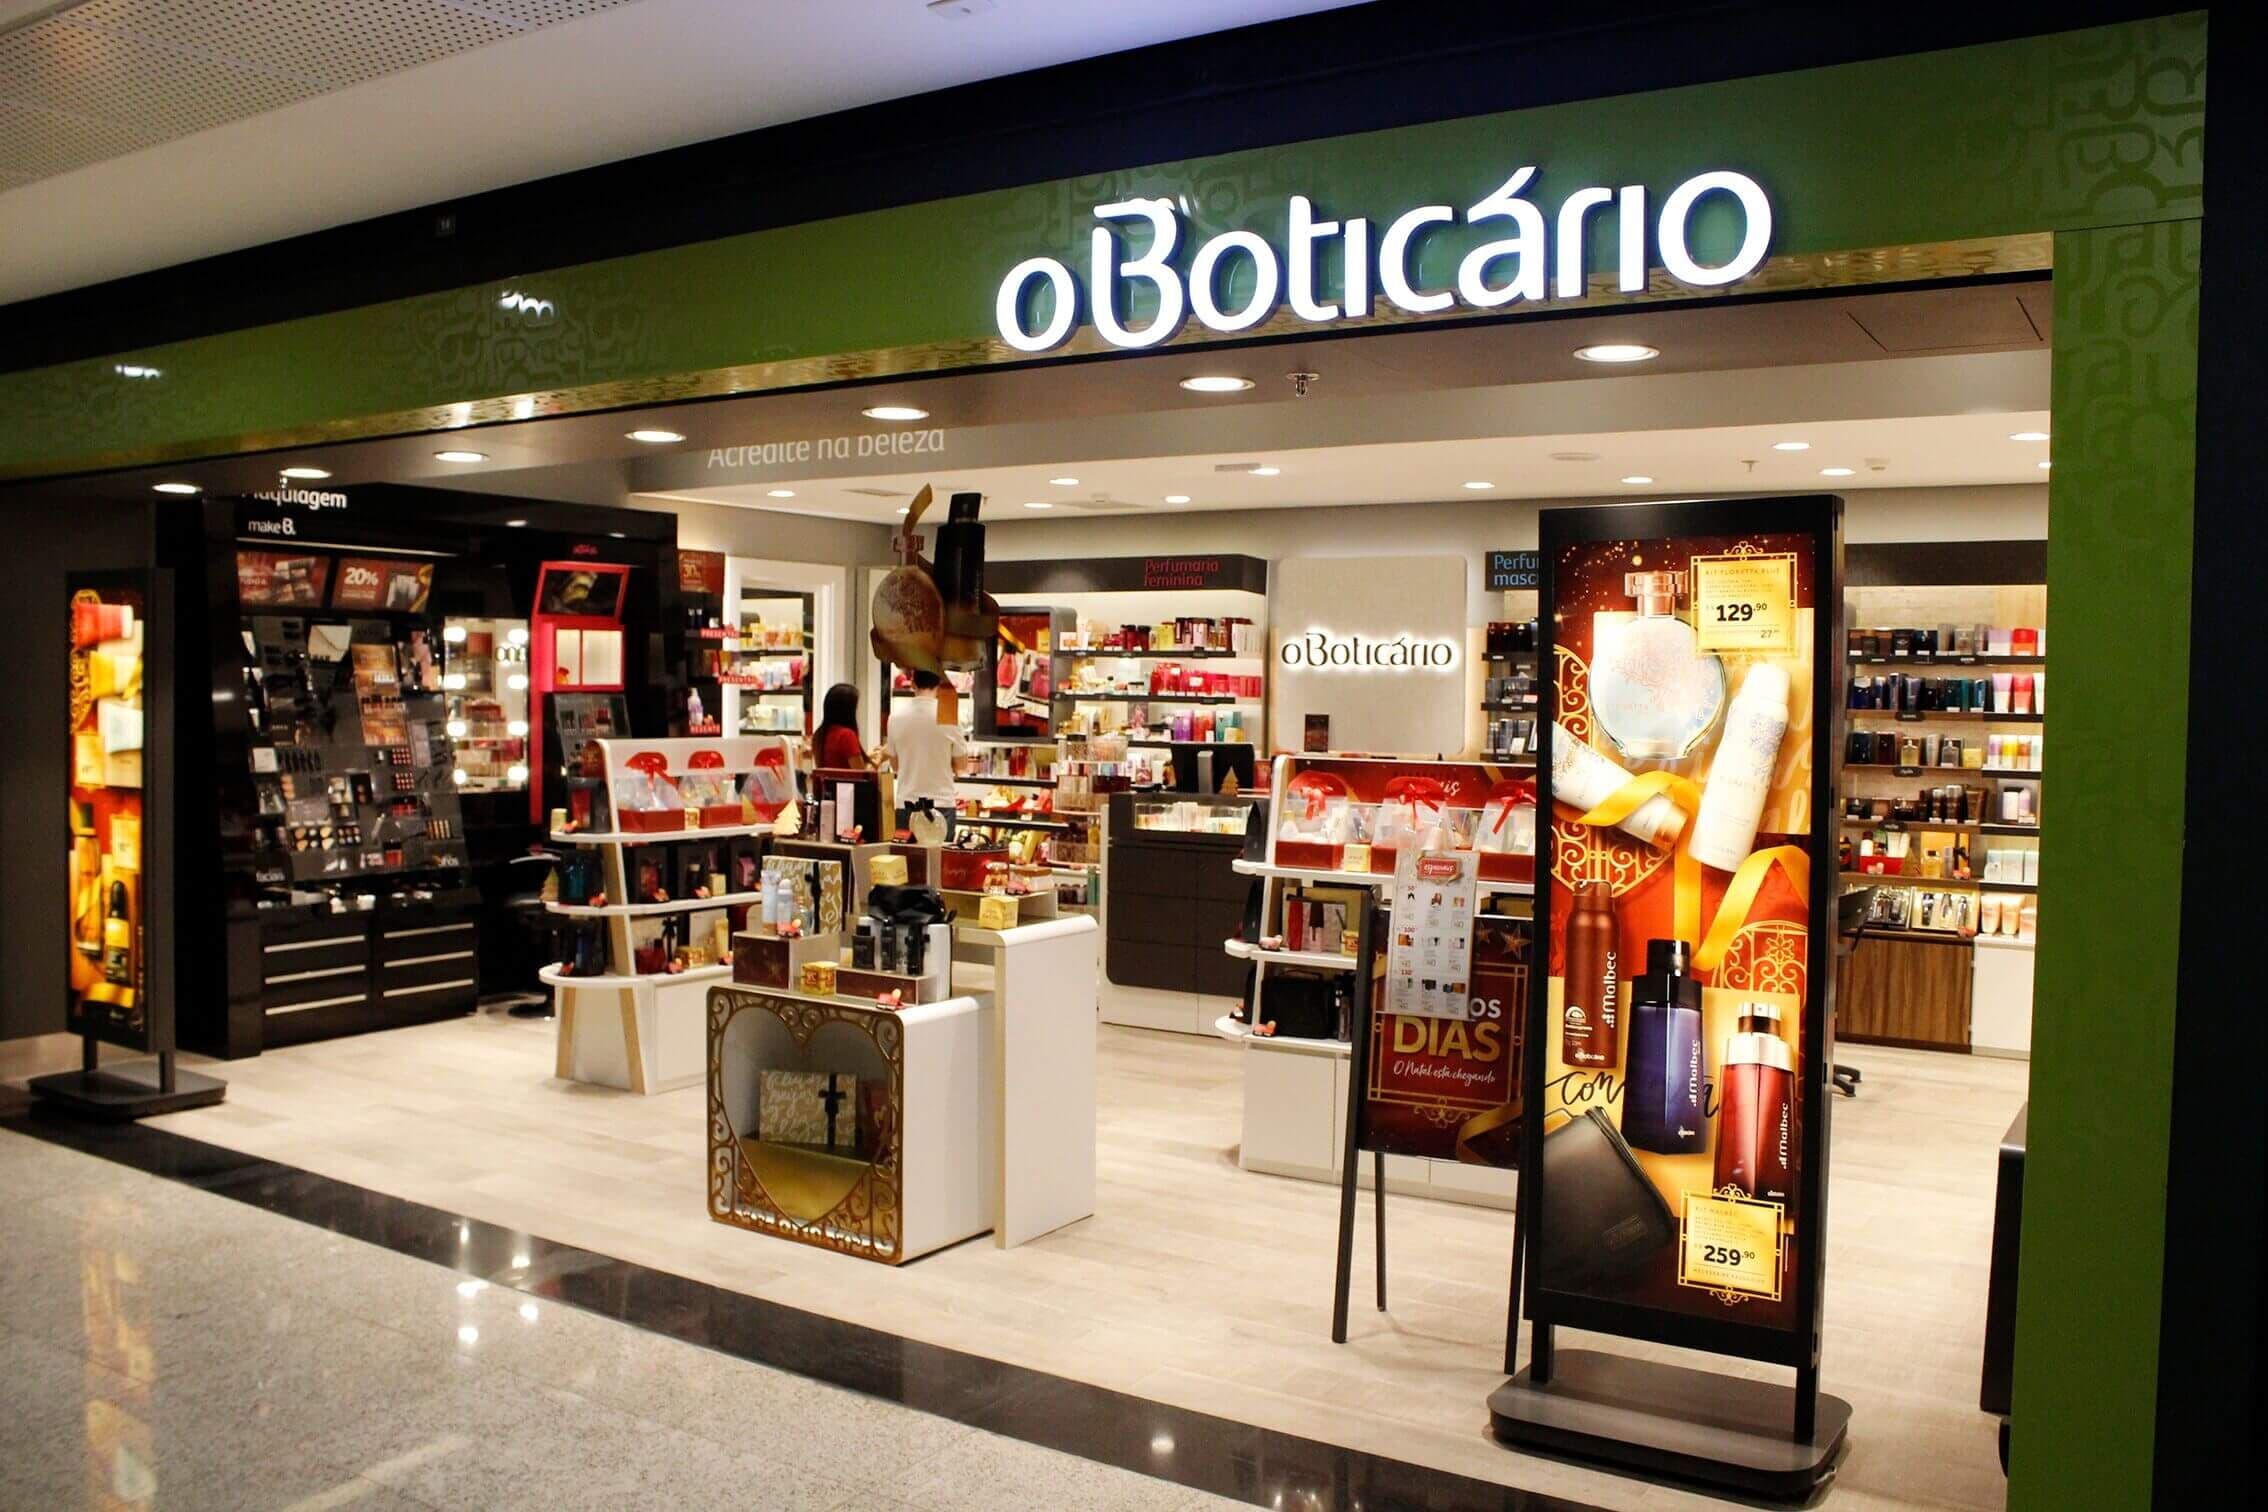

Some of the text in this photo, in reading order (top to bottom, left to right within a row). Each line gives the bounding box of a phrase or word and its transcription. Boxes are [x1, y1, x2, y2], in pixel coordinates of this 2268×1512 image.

[707, 440, 809, 469] Acredite
[818, 436, 849, 459] na
[242, 488, 347, 510] aquiagem
[344, 567, 379, 587] 20%
[1494, 572, 1540, 586] masc
[1393, 1014, 1501, 1062] DIAS
